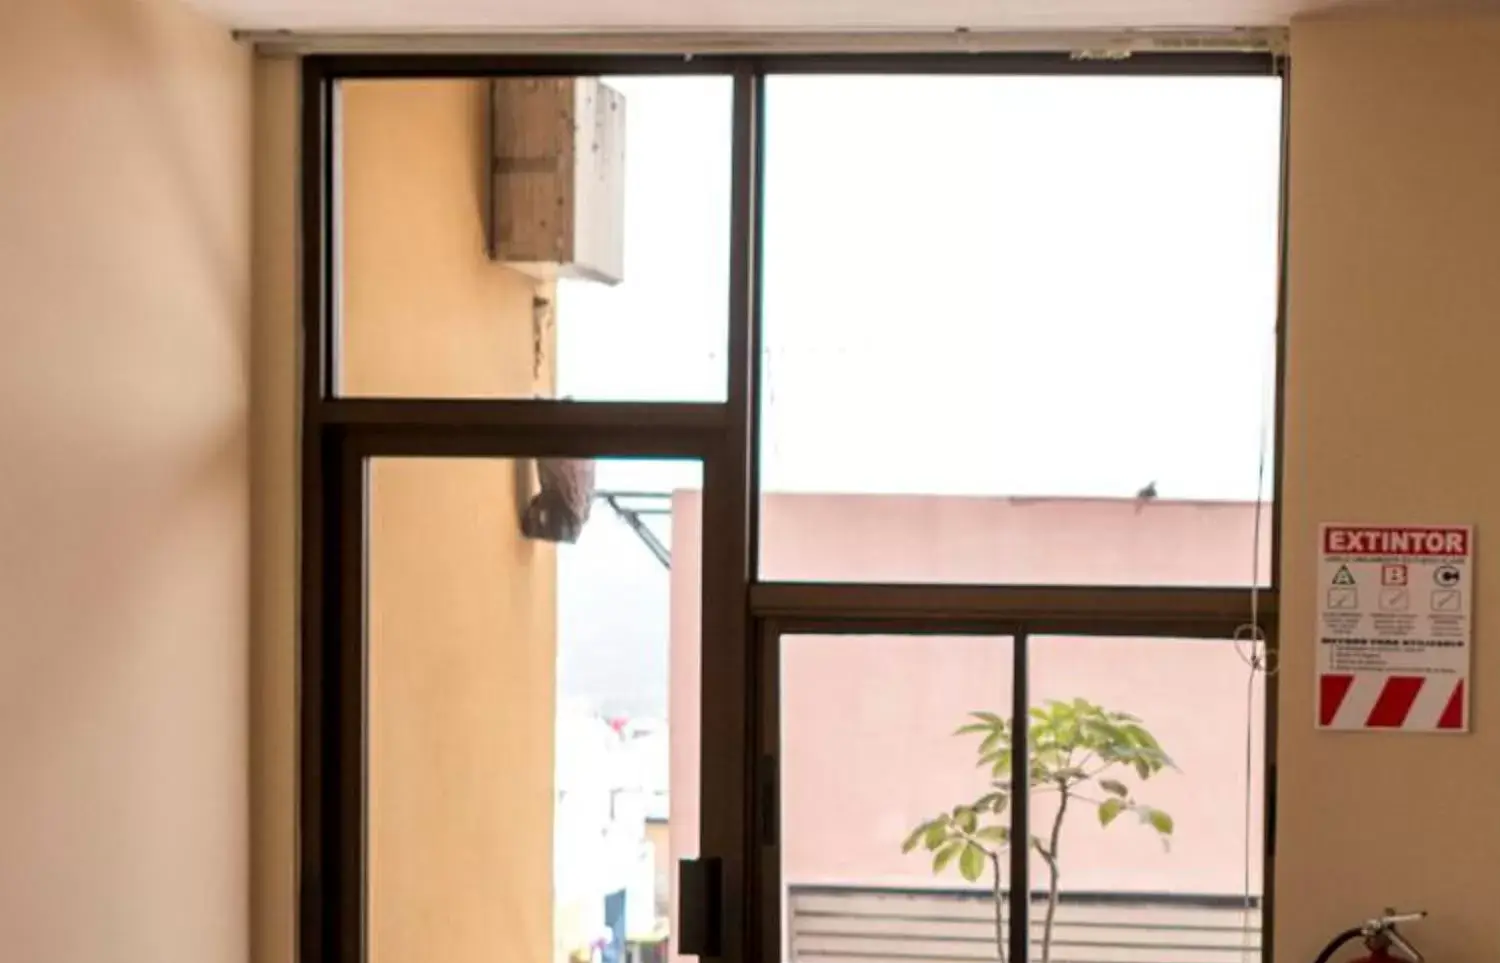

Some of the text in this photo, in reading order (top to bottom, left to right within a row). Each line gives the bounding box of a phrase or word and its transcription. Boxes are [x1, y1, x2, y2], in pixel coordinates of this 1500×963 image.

[1329, 531, 1463, 553] EXTINTOR
[1385, 567, 1404, 584] B
[1435, 566, 1459, 585] C
